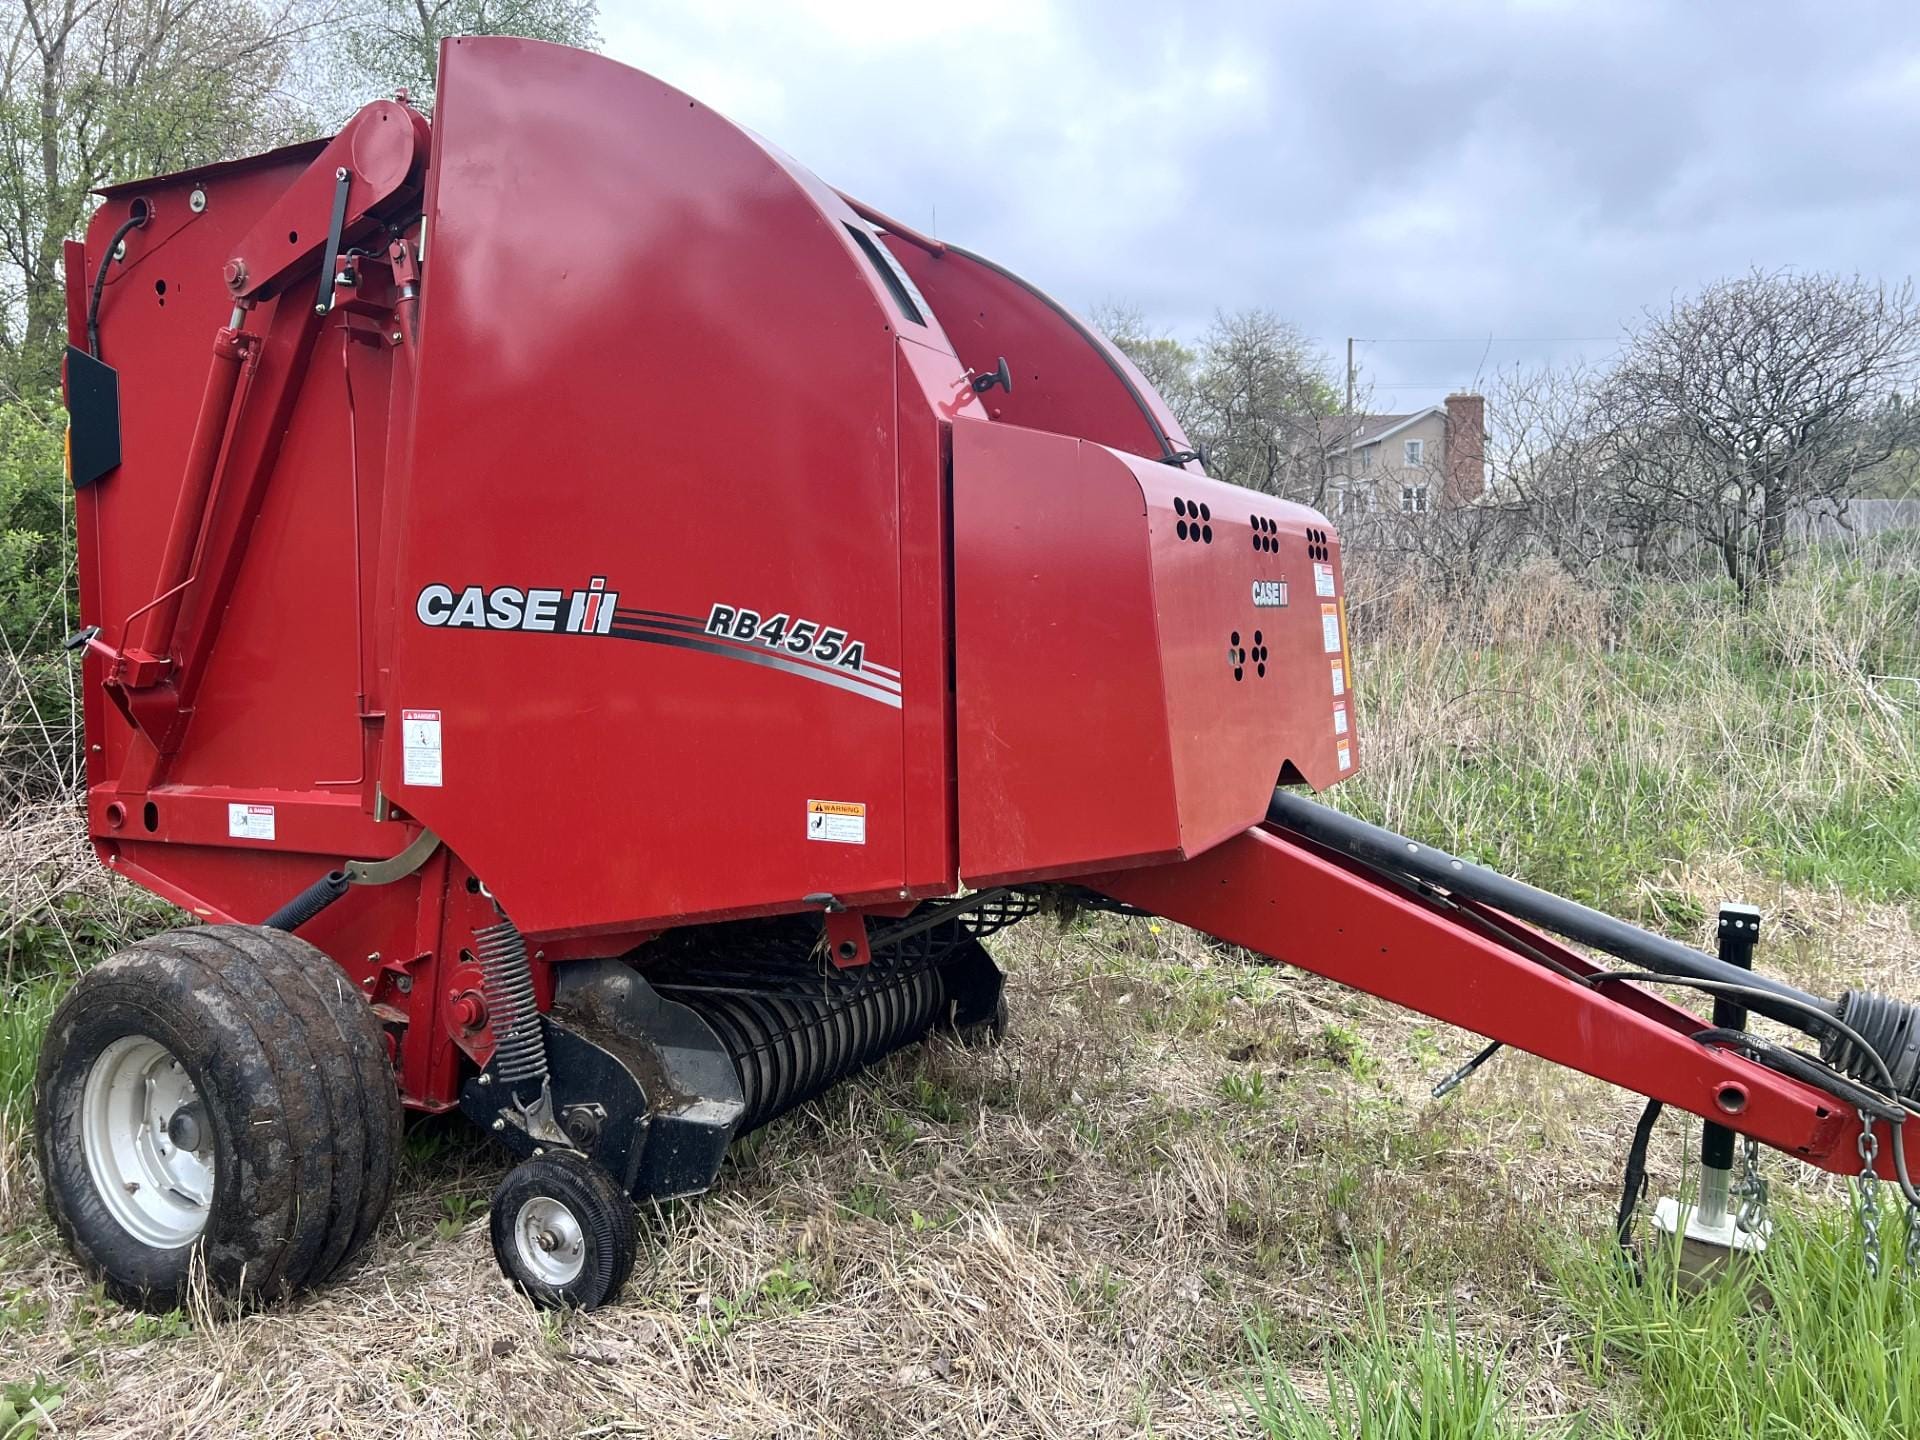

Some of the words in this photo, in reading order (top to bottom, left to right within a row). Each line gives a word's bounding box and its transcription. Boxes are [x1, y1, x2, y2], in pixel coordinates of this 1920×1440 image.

[417, 585, 562, 630] CASE
[1252, 581, 1279, 606] CASE
[705, 603, 865, 672] RB455A
[823, 804, 860, 814] WARNING
